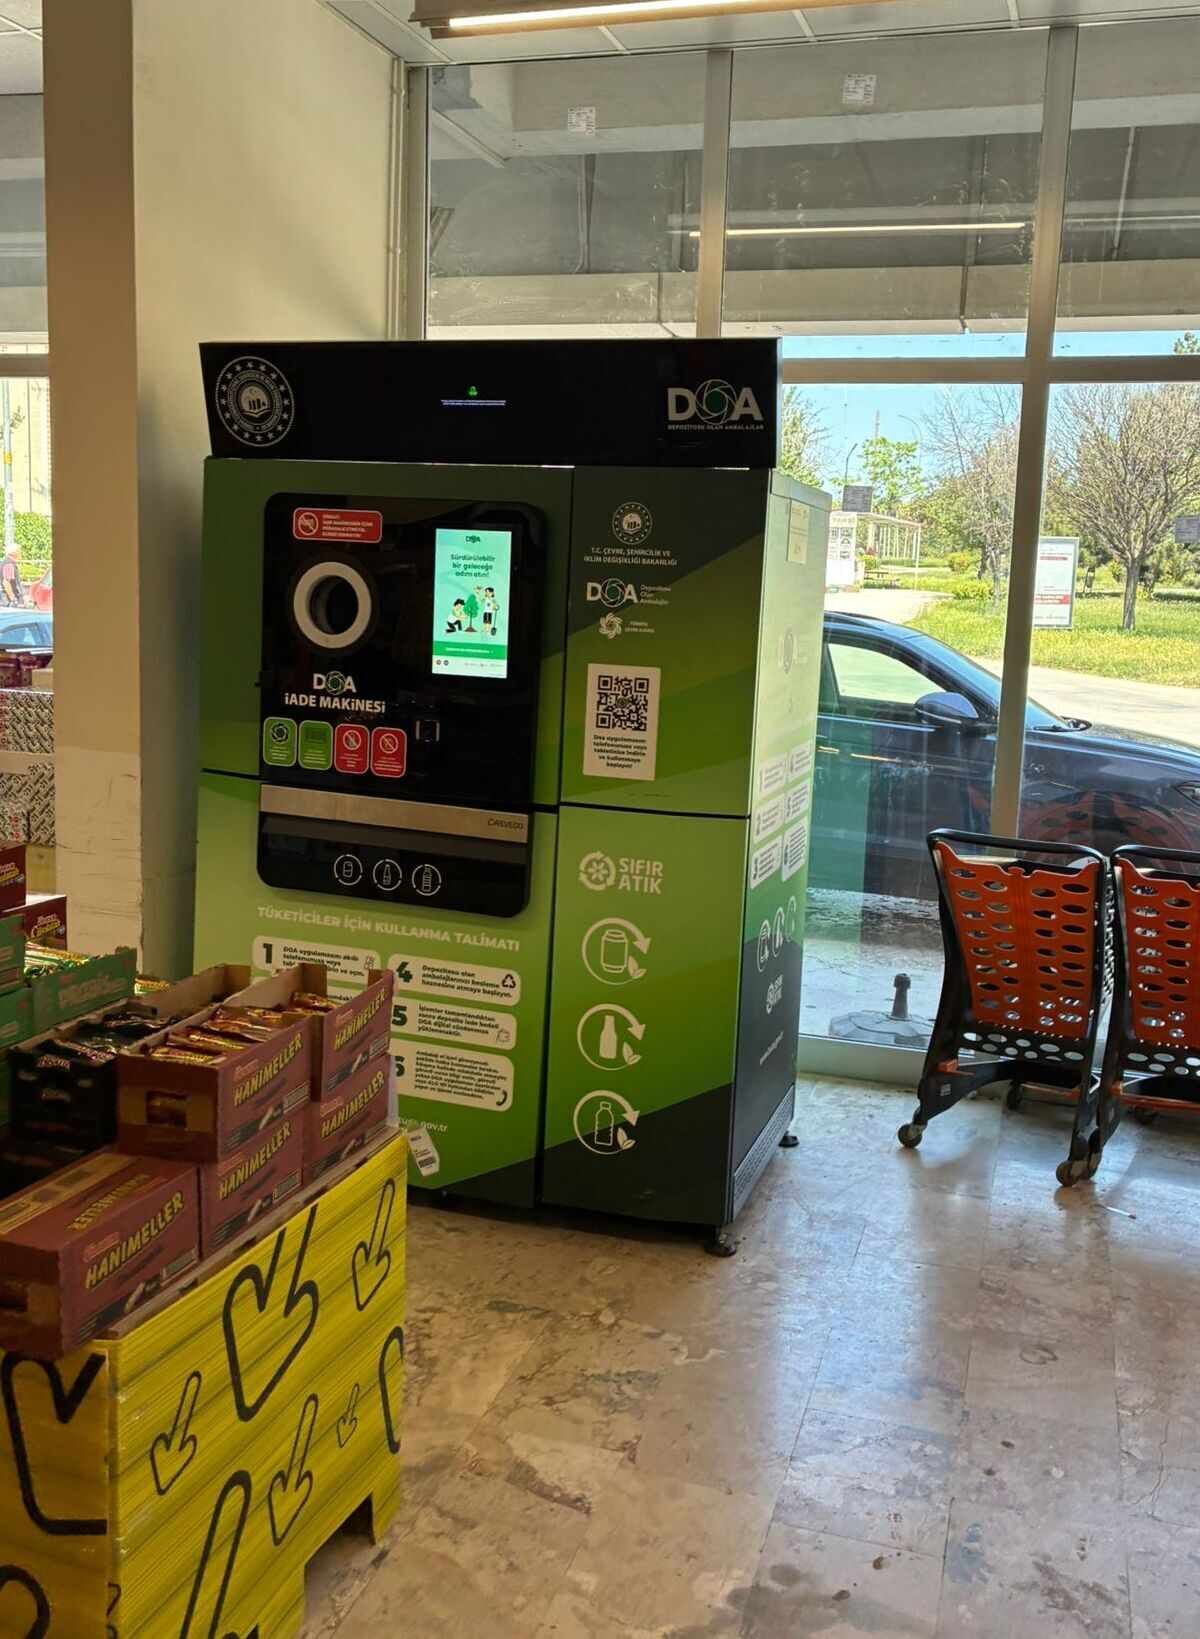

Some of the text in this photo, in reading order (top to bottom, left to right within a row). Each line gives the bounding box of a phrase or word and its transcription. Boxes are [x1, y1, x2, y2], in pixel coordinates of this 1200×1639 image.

[667, 379, 763, 425] DOA
[586, 578, 639, 608] DOA
[313, 671, 357, 695] DOA
[619, 857, 663, 877] SIFIR
[618, 874, 663, 894] ATIK
[257, 905, 520, 952] TÜKETİCİLER İÇİN KULLANMA TALİMATI
[263, 943, 273, 964] 1
[395, 961, 413, 983] 4
[391, 1005, 408, 1026] 5
[233, 1031, 302, 1107] HANIMELLER
[321, 1070, 385, 1138] HANIMELLER
[219, 1120, 291, 1200] HANIMELLER
[85, 1191, 184, 1289] HANIMELLER
